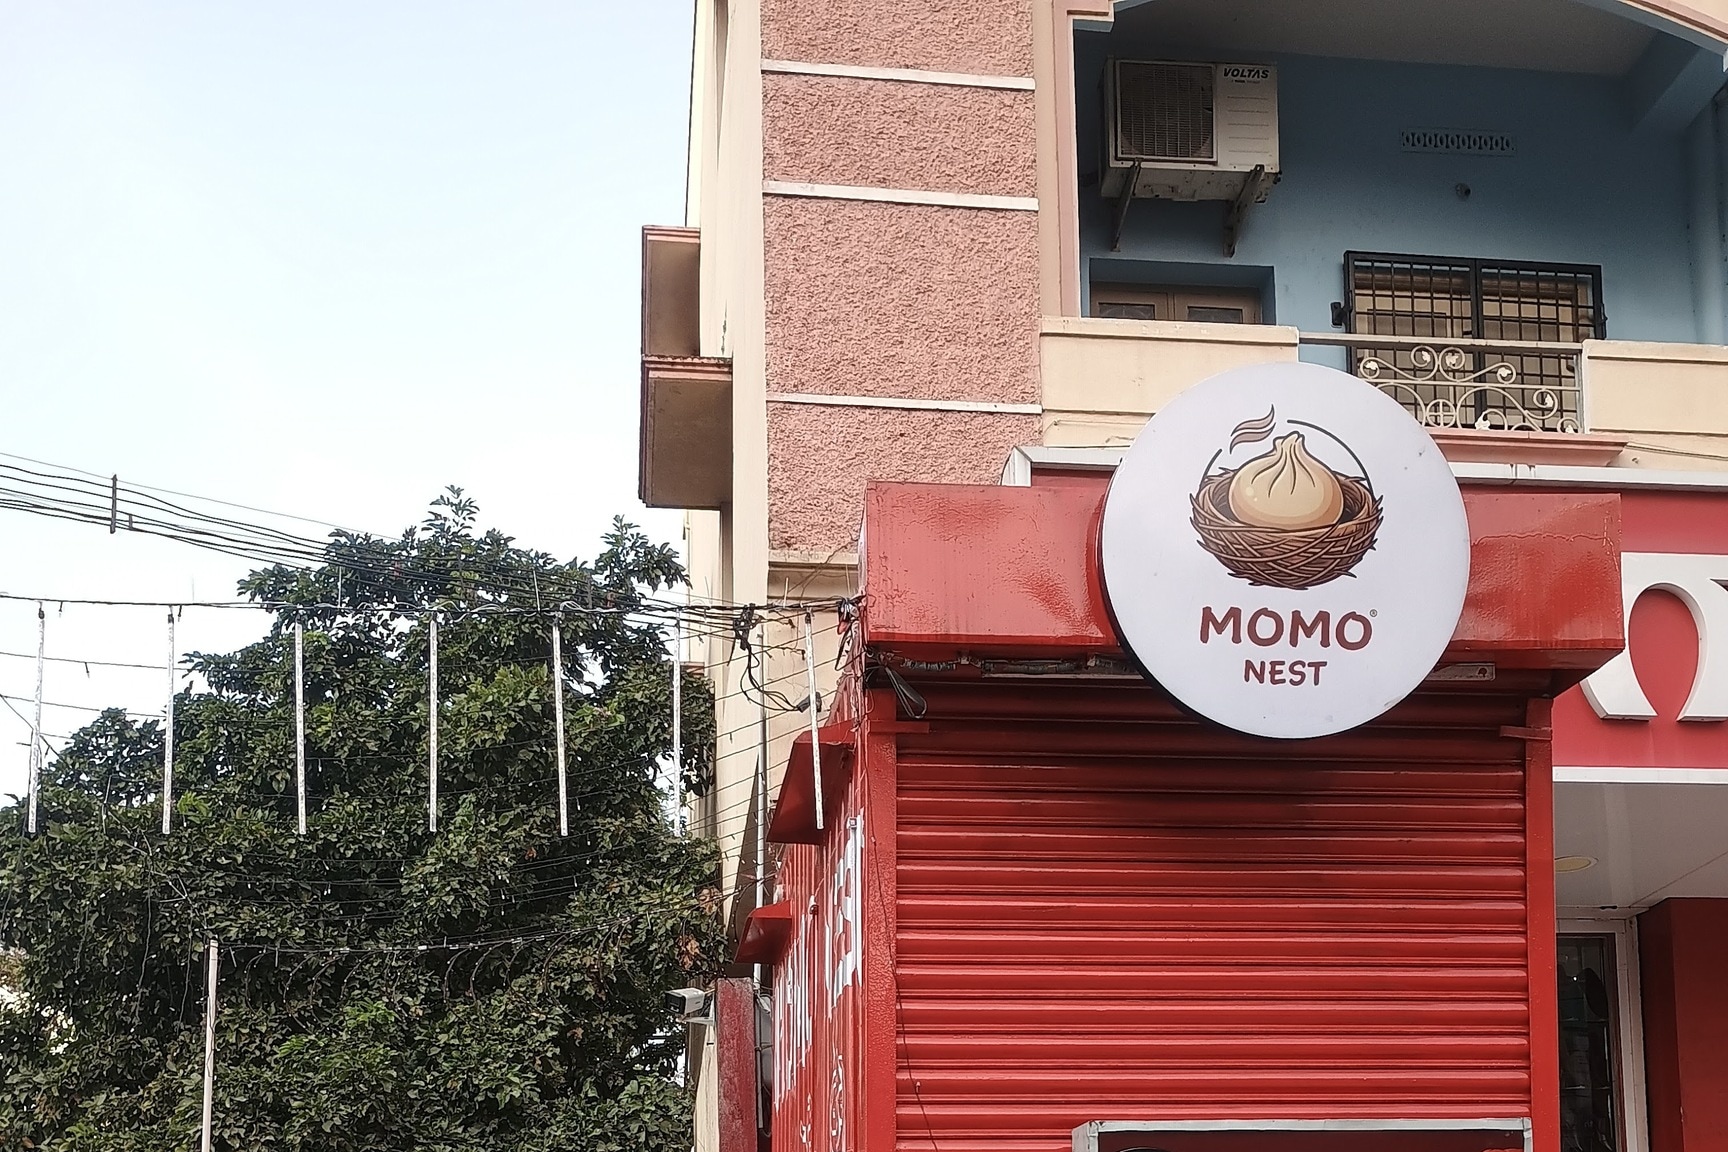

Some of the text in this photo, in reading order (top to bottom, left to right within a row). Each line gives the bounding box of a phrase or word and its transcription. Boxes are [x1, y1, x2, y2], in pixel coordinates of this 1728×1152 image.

[1223, 67, 1270, 79] VOLTAS
[1199, 606, 1373, 651] MOMO
[1244, 659, 1328, 687] NEST
